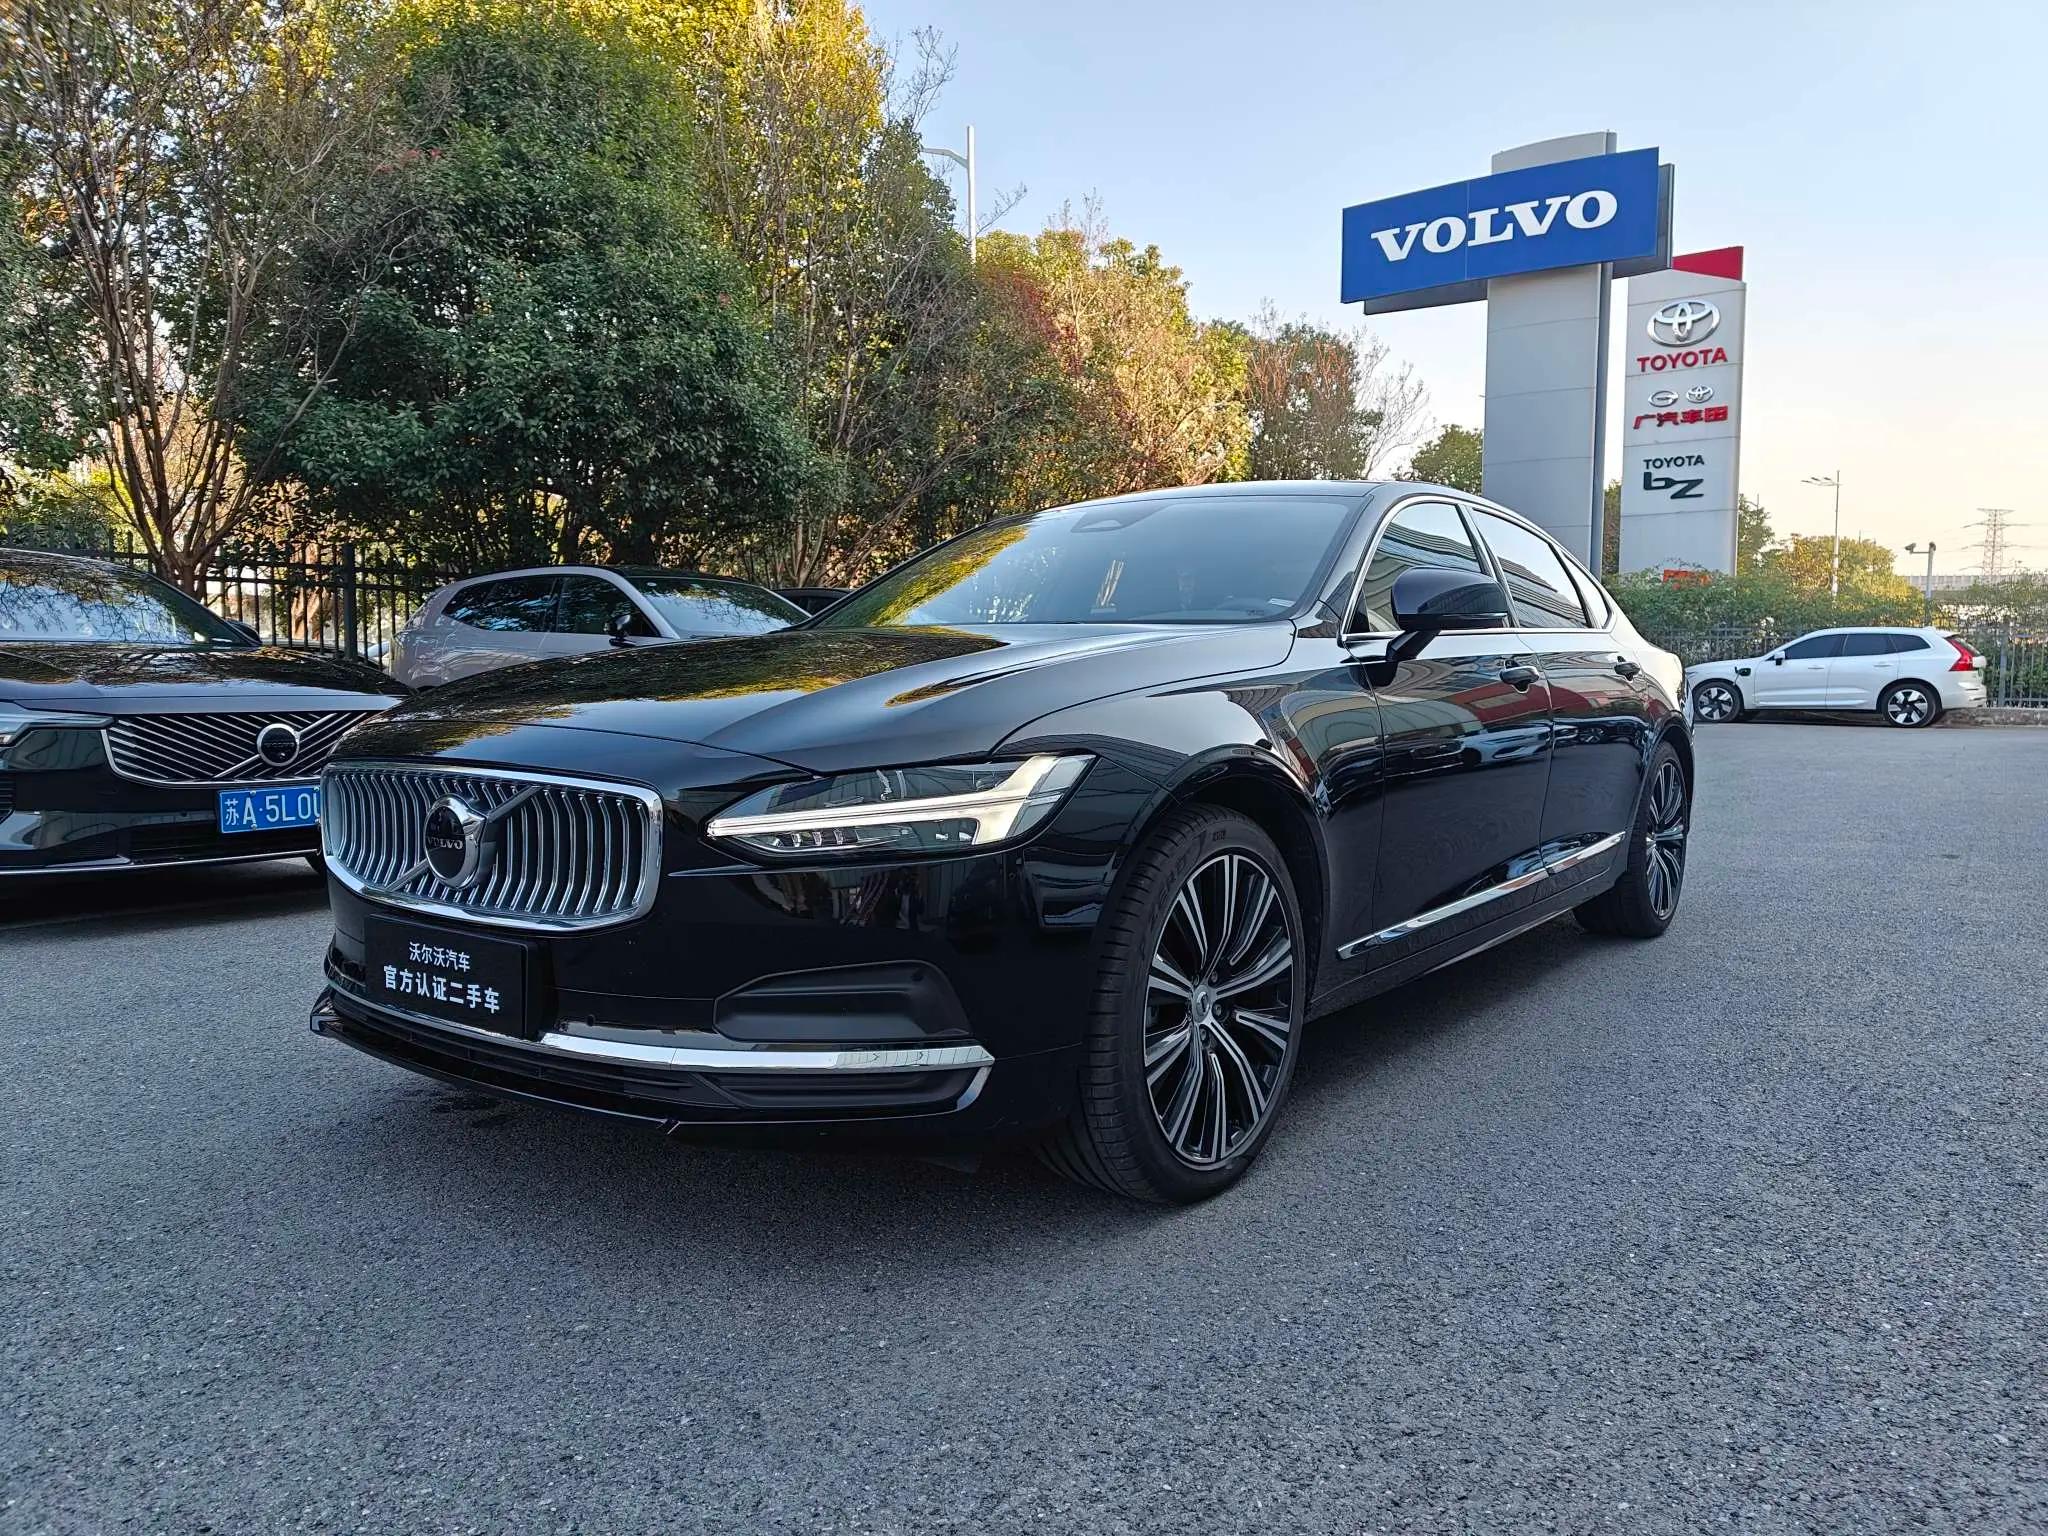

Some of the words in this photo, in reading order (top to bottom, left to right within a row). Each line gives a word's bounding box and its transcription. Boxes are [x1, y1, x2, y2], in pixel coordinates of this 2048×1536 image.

[1371, 190, 1618, 262] VOLVO
[1637, 347, 1728, 373] TOYOTA
[1643, 455, 1705, 470] TOYOTA
[409, 941, 470, 973] 沃尔沃汽车
[383, 964, 500, 1014] 官方认证二手车
